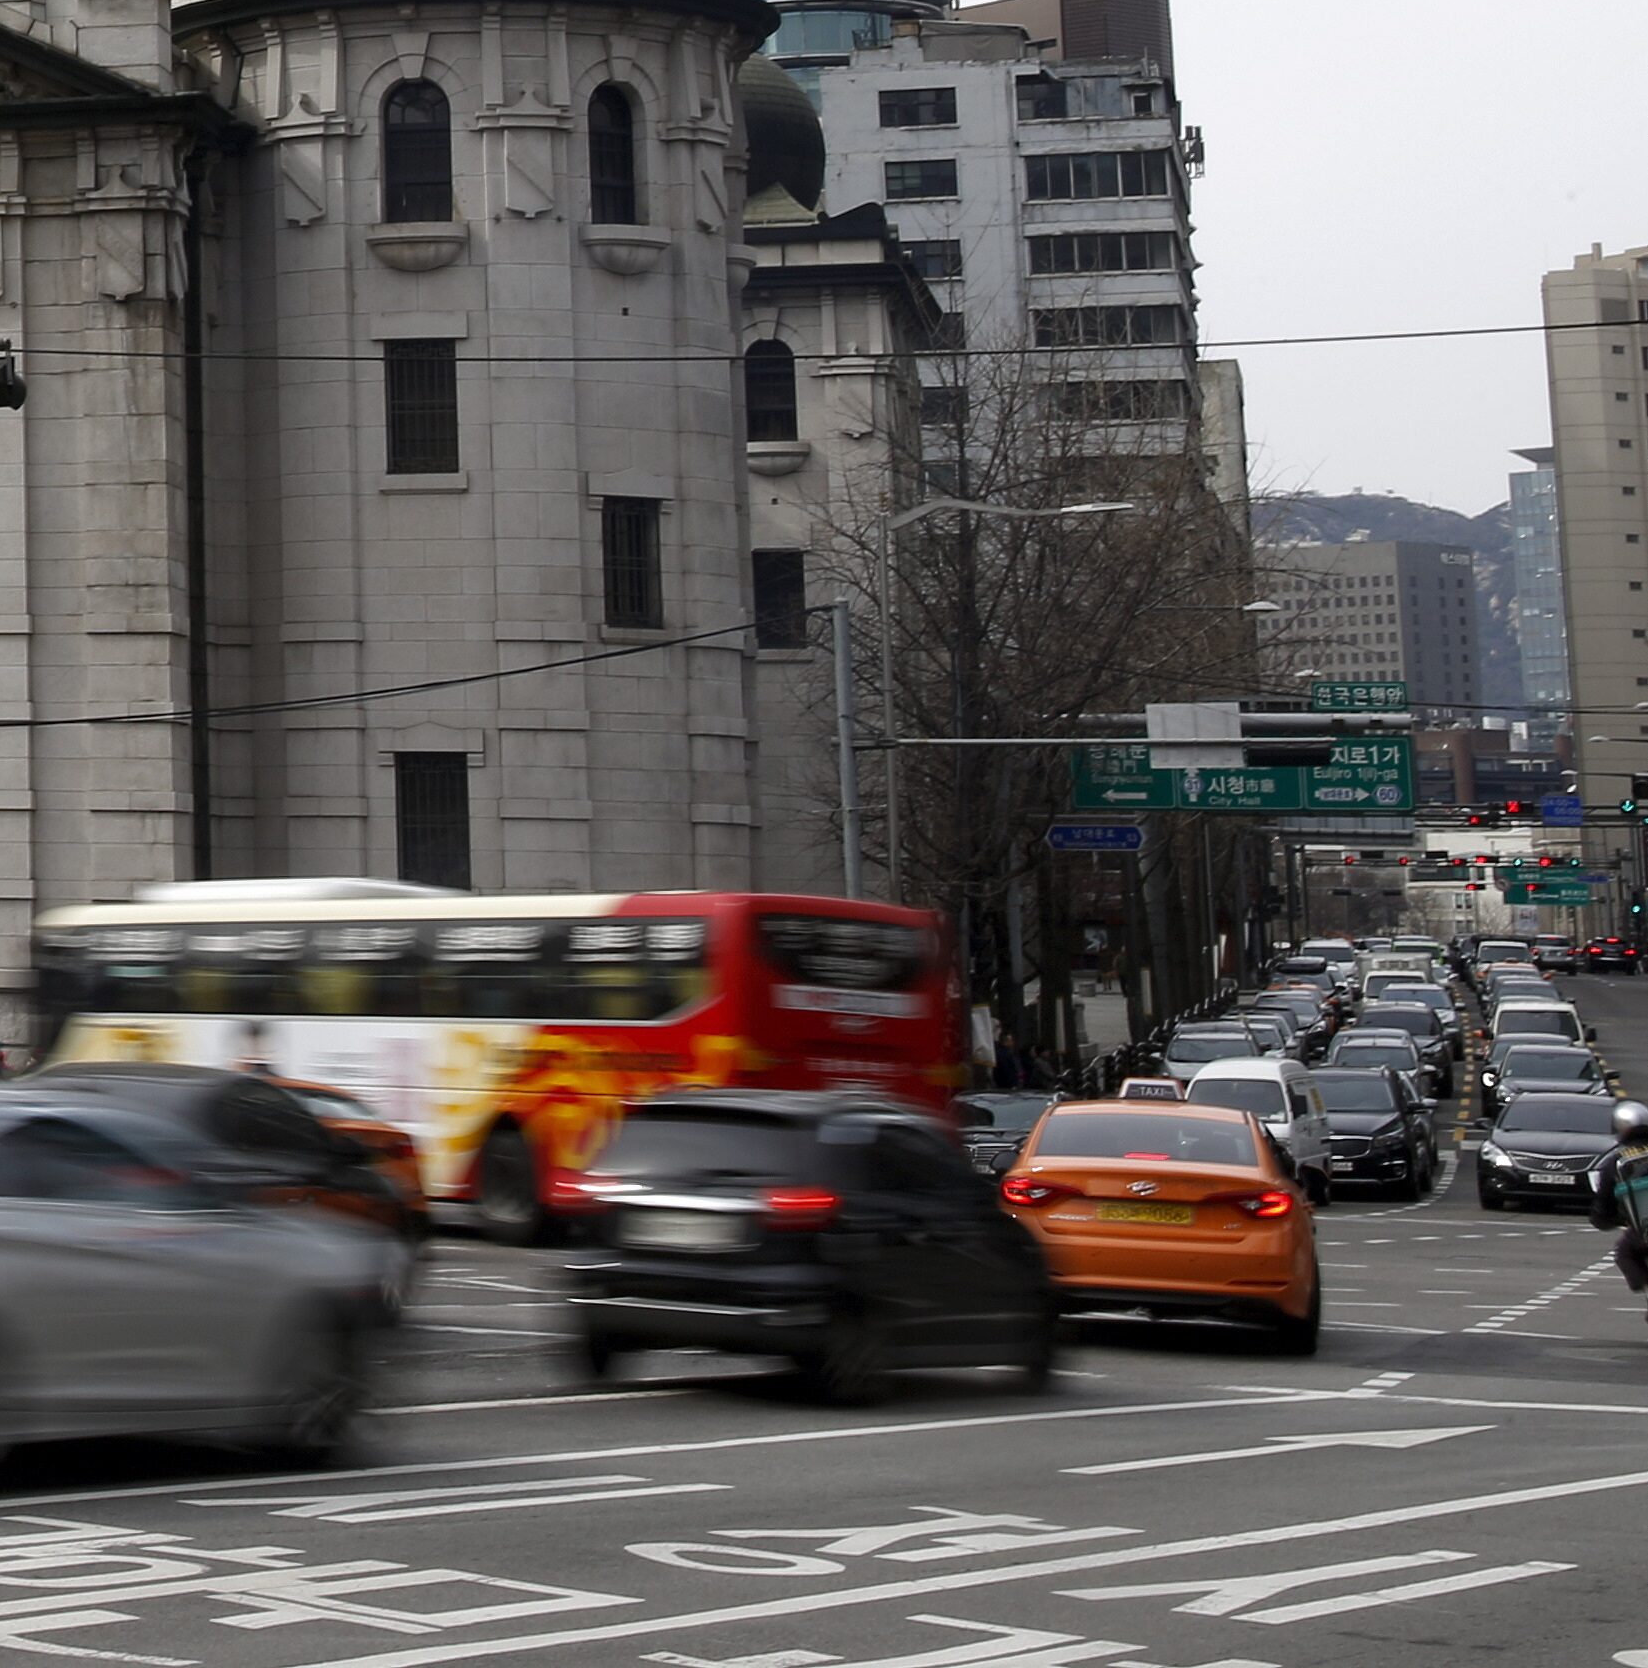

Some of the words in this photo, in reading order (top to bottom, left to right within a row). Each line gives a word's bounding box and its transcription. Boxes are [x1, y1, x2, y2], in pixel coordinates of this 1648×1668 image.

[1329, 745, 1401, 764] 지로1가
[1209, 796, 1232, 806] City
[1239, 796, 1261, 805] Hall
[1379, 788, 1399, 802] 60
[1139, 1085, 1165, 1097] TAXI
